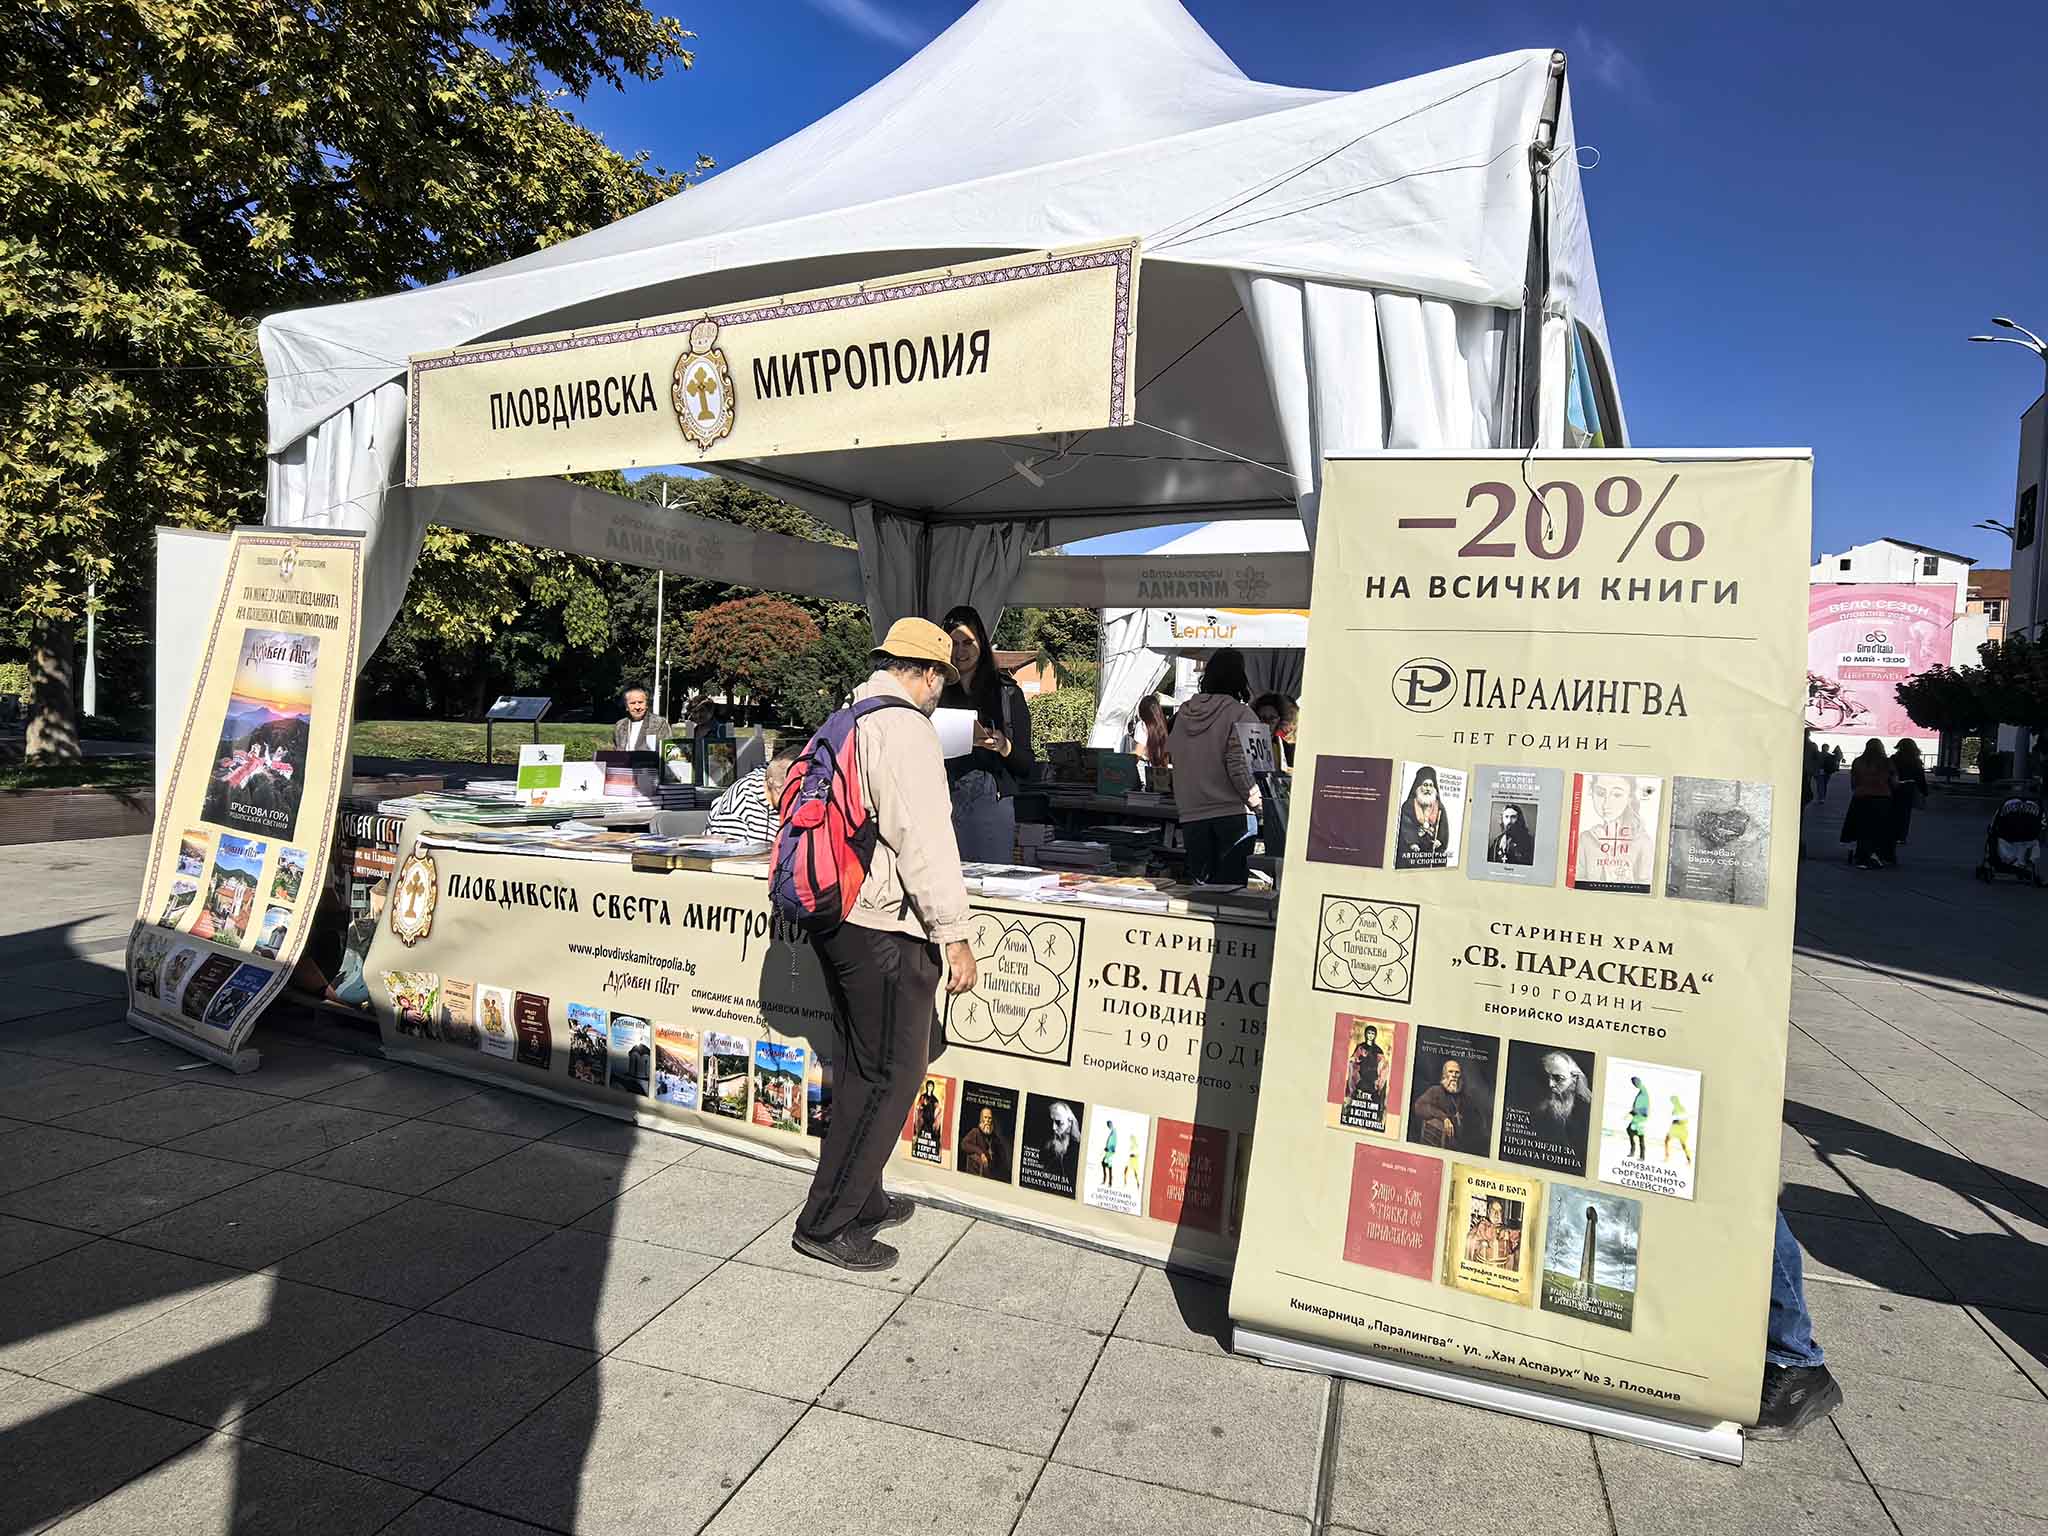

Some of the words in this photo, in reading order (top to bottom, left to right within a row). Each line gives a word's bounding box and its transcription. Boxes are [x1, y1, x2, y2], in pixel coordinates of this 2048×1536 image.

[490, 372, 657, 430] ПЛОВДИВСКА
[752, 329, 990, 400] МИТРОПОЛИЯ
[300, 592, 340, 609] ИЗДАНИЯТА
[1366, 575, 1411, 599] НА
[1428, 575, 1580, 600] ВСИЧКИ
[1601, 576, 1739, 604] КНИГИ
[294, 611, 340, 630] МИТРОПОЛИЯ
[1854, 655, 1875, 663] МАЙ
[1857, 643, 1871, 653] Giro
[1463, 668, 1688, 717] ПАРАЛИНГВА
[1453, 731, 1495, 745] ПЕТ
[1507, 733, 1609, 750] ГОДИНИ
[231, 801, 268, 818] КРЪСТОВА
[269, 807, 289, 822] ГОРА
[448, 874, 579, 912] ПЛОВДИВСКА
[592, 892, 672, 926] СВЕТА
[1125, 928, 1257, 959] СТАРИНЕН
[1489, 922, 1603, 948] СТАРИНЕН
[1613, 935, 1675, 956] ХРАМ
[568, 943, 696, 976] www.plovdivskamitropolia.bg
[998, 954, 1029, 977] Света
[983, 972, 1041, 997] Параскева
[1158, 968, 1271, 1008] ПАРАС
[691, 988, 733, 1004] СПИСАНИЕ
[733, 996, 745, 1007] НА
[745, 998, 800, 1017] ПЛОВДИВСКА
[1510, 983, 1541, 998] 190
[1553, 988, 1644, 1012] ГОДИНИ
[691, 1004, 767, 1028] www.duhoven.bg
[1102, 997, 1207, 1027] ПЛОВДИВ
[1484, 1002, 1563, 1024] ЕНОРИЙСКО
[1568, 1014, 1667, 1039] ИЗДАТЕЛСТВО
[1124, 1028, 1169, 1052] 190
[1083, 1053, 1149, 1076] Енорийско
[1152, 1068, 1232, 1091] издателство
[1505, 1113, 1531, 1125] ЛУКА
[1504, 1135, 1564, 1154] ПРОПОВЕДИ
[1541, 1151, 1583, 1169] ГОДИНА
[1621, 1159, 1663, 1175] КРИЗАТА
[1664, 1167, 1678, 1178] НА
[1611, 1166, 1687, 1189] СЪВРЕМЕННОТО
[1620, 1177, 1676, 1195] СЕМЕЙСТВО
[1506, 1185, 1527, 1197] БОГА
[1290, 1297, 1365, 1327] Книжарница
[1463, 1344, 1482, 1357] ул.
[1583, 1371, 1600, 1384] №
[1603, 1376, 1615, 1388] 3,
[1619, 1379, 1682, 1402] Пловдив
